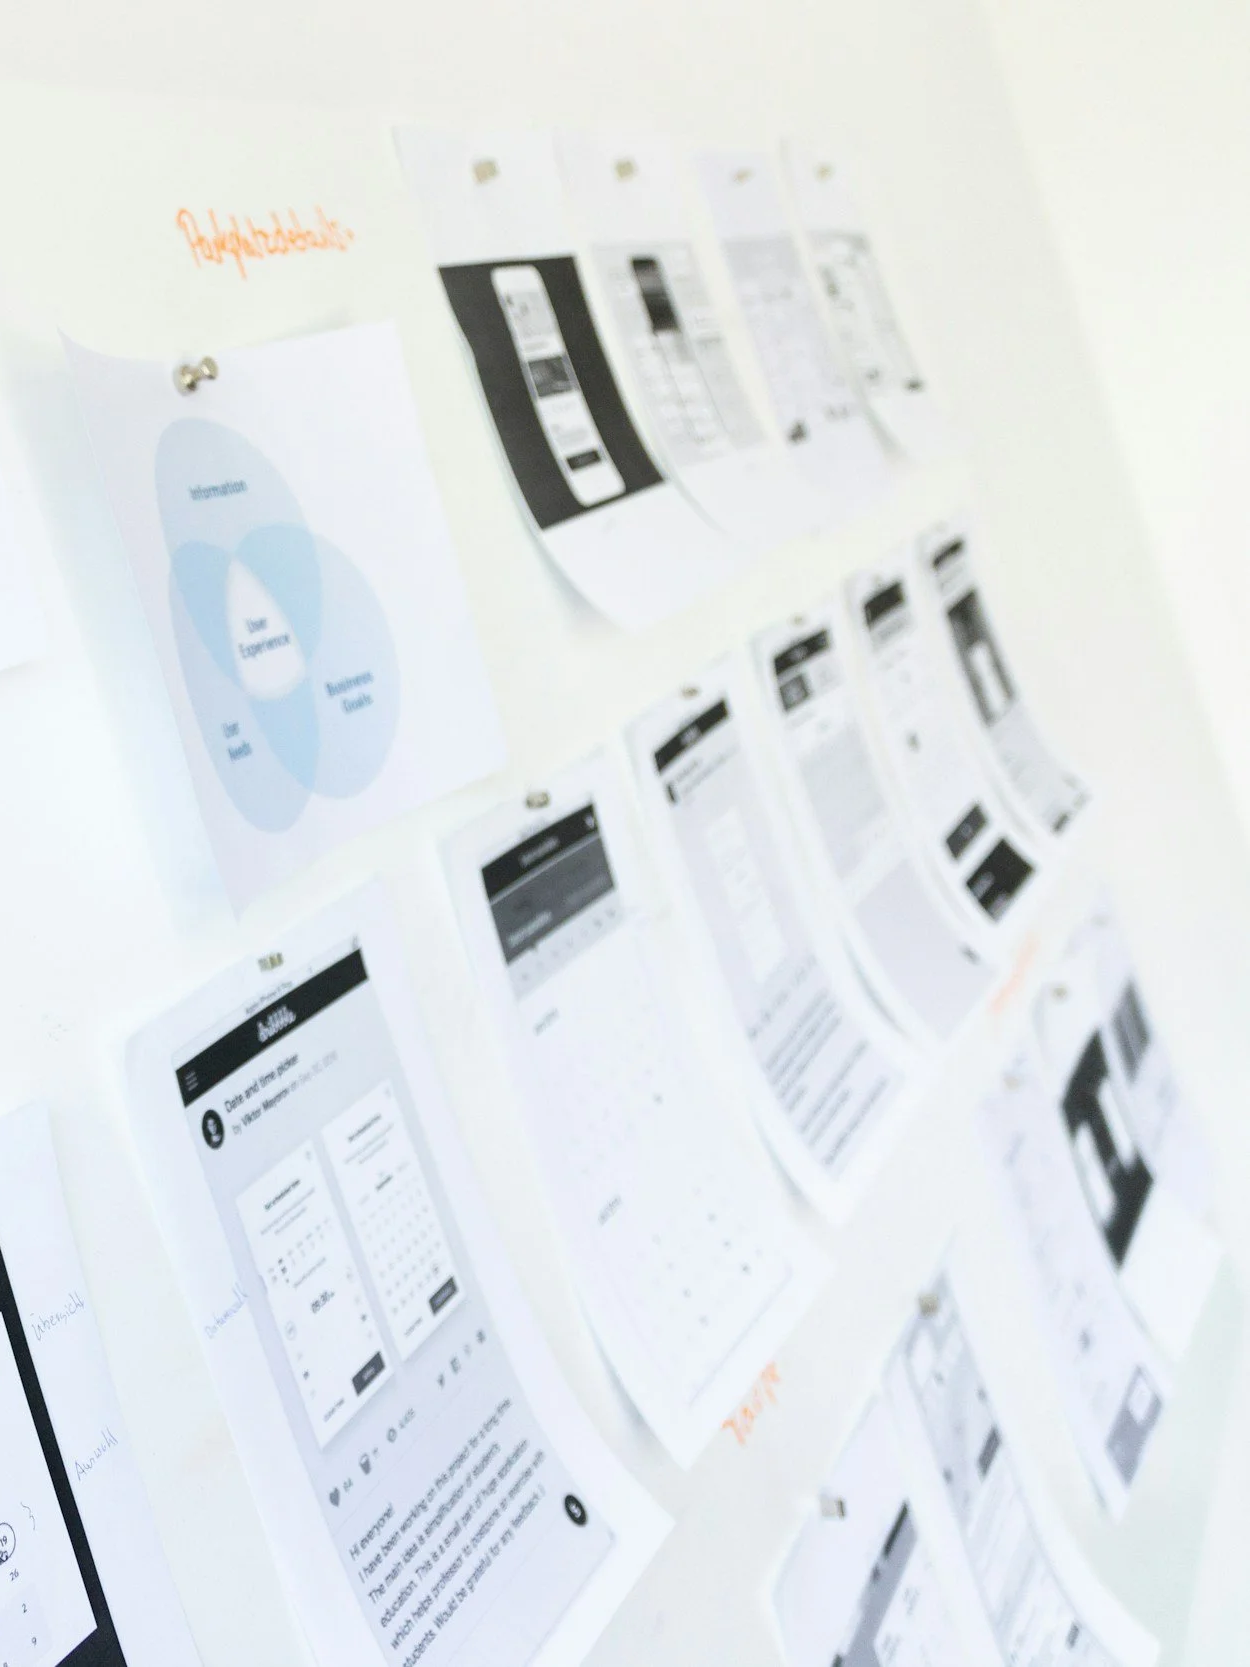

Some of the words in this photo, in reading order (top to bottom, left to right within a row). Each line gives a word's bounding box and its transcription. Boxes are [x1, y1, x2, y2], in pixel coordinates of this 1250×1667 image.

[188, 479, 247, 500] Information
[238, 633, 290, 659] Experience
[224, 1090, 244, 1113] Date
[245, 1079, 260, 1098] and
[260, 1069, 276, 1090] time
[276, 1053, 300, 1078] picker
[0, 1535, 8, 1548] 19
[349, 1542, 361, 1561] Hi
[362, 1553, 382, 1578] have
[381, 1531, 401, 1557] been
[400, 1499, 429, 1533] working
[415, 1560, 433, 1581] This
[431, 1551, 439, 1563] is
[444, 1520, 461, 1548] small
[9, 1568, 20, 1582] 26
[368, 1583, 386, 1604] The
[385, 1562, 403, 1588] main
[402, 1543, 419, 1563] idea
[391, 1618, 414, 1650] which
[411, 1594, 433, 1623] helps
[431, 1553, 463, 1598] professor
[433, 1600, 459, 1630] Would
[455, 1587, 467, 1602] be
